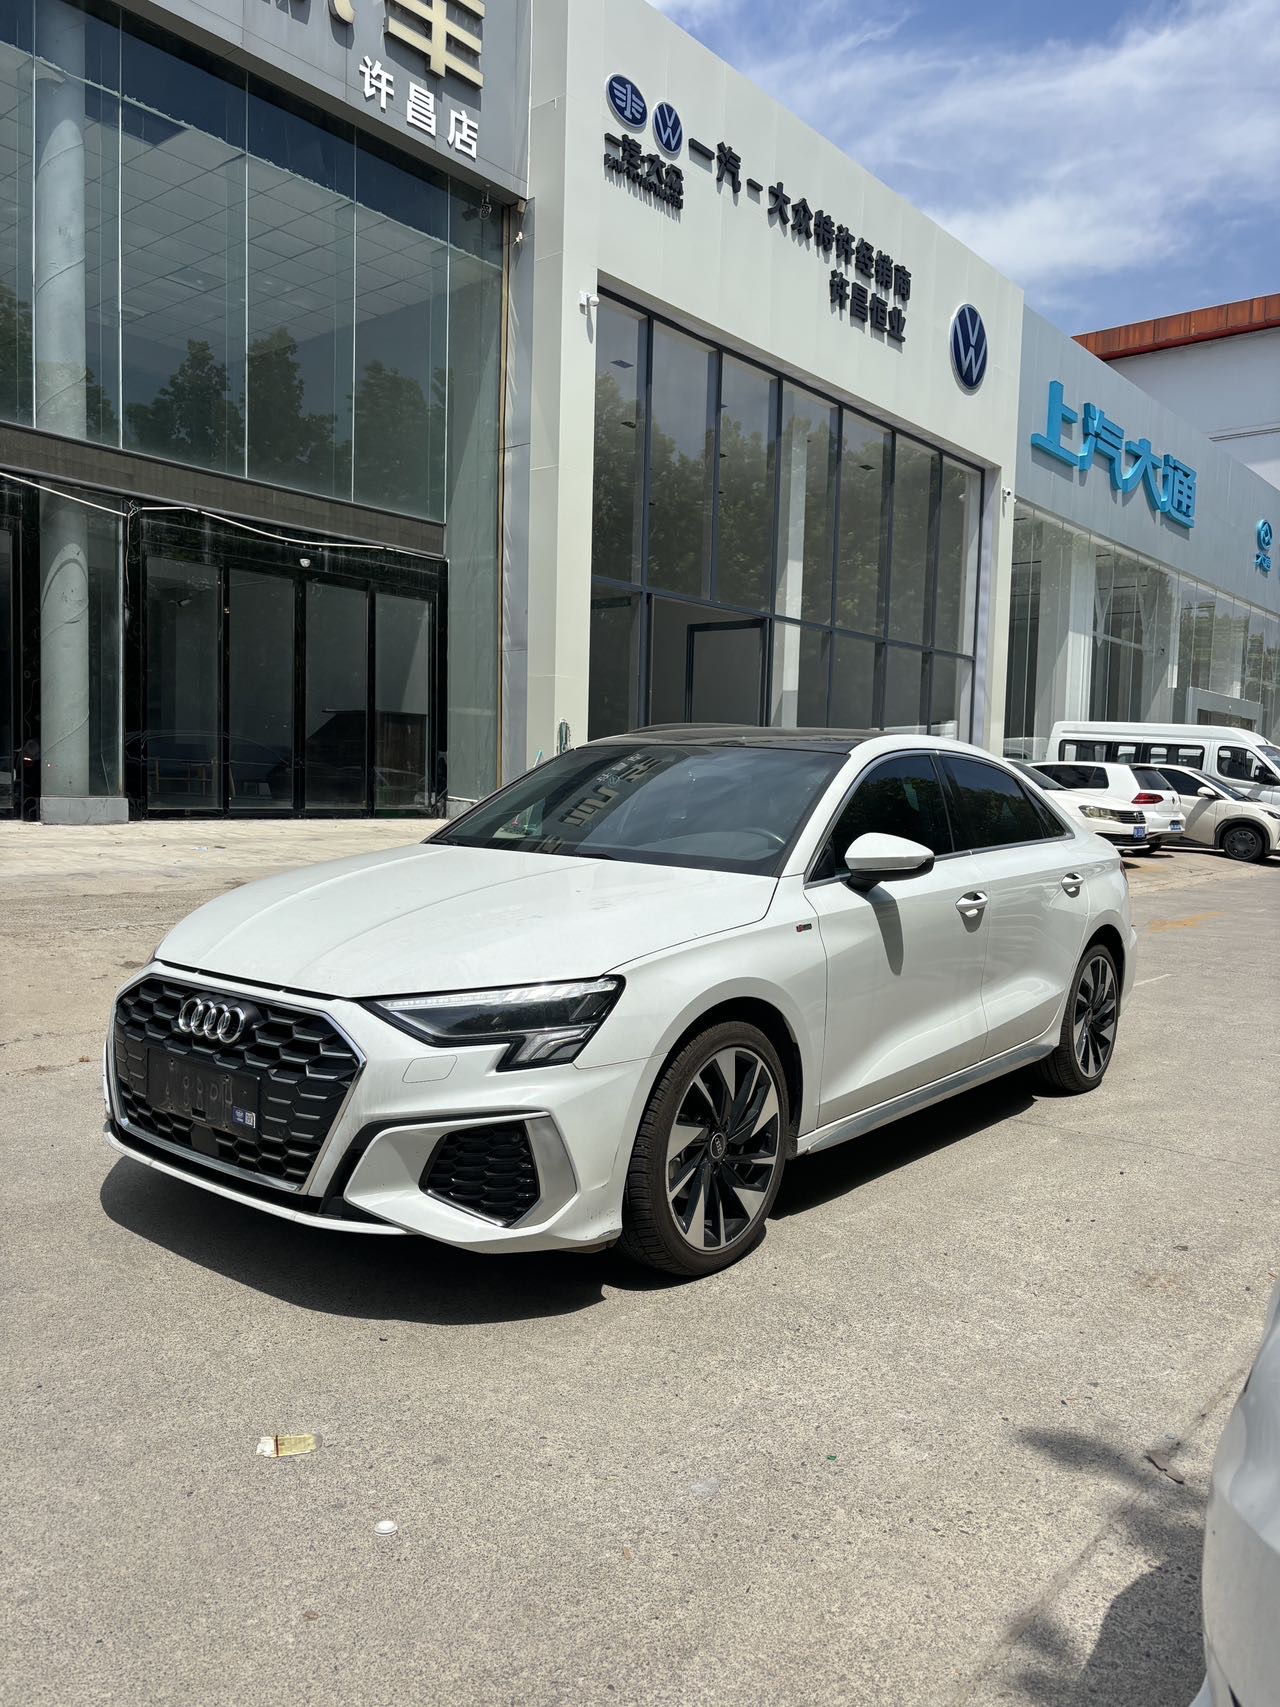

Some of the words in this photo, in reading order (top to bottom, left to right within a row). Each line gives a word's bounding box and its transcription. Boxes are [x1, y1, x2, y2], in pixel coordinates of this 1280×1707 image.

[358, 56, 479, 160] 许昌店
[829, 269, 906, 342] 许昌恒业
[1031, 380, 1197, 529] 上汽大通
